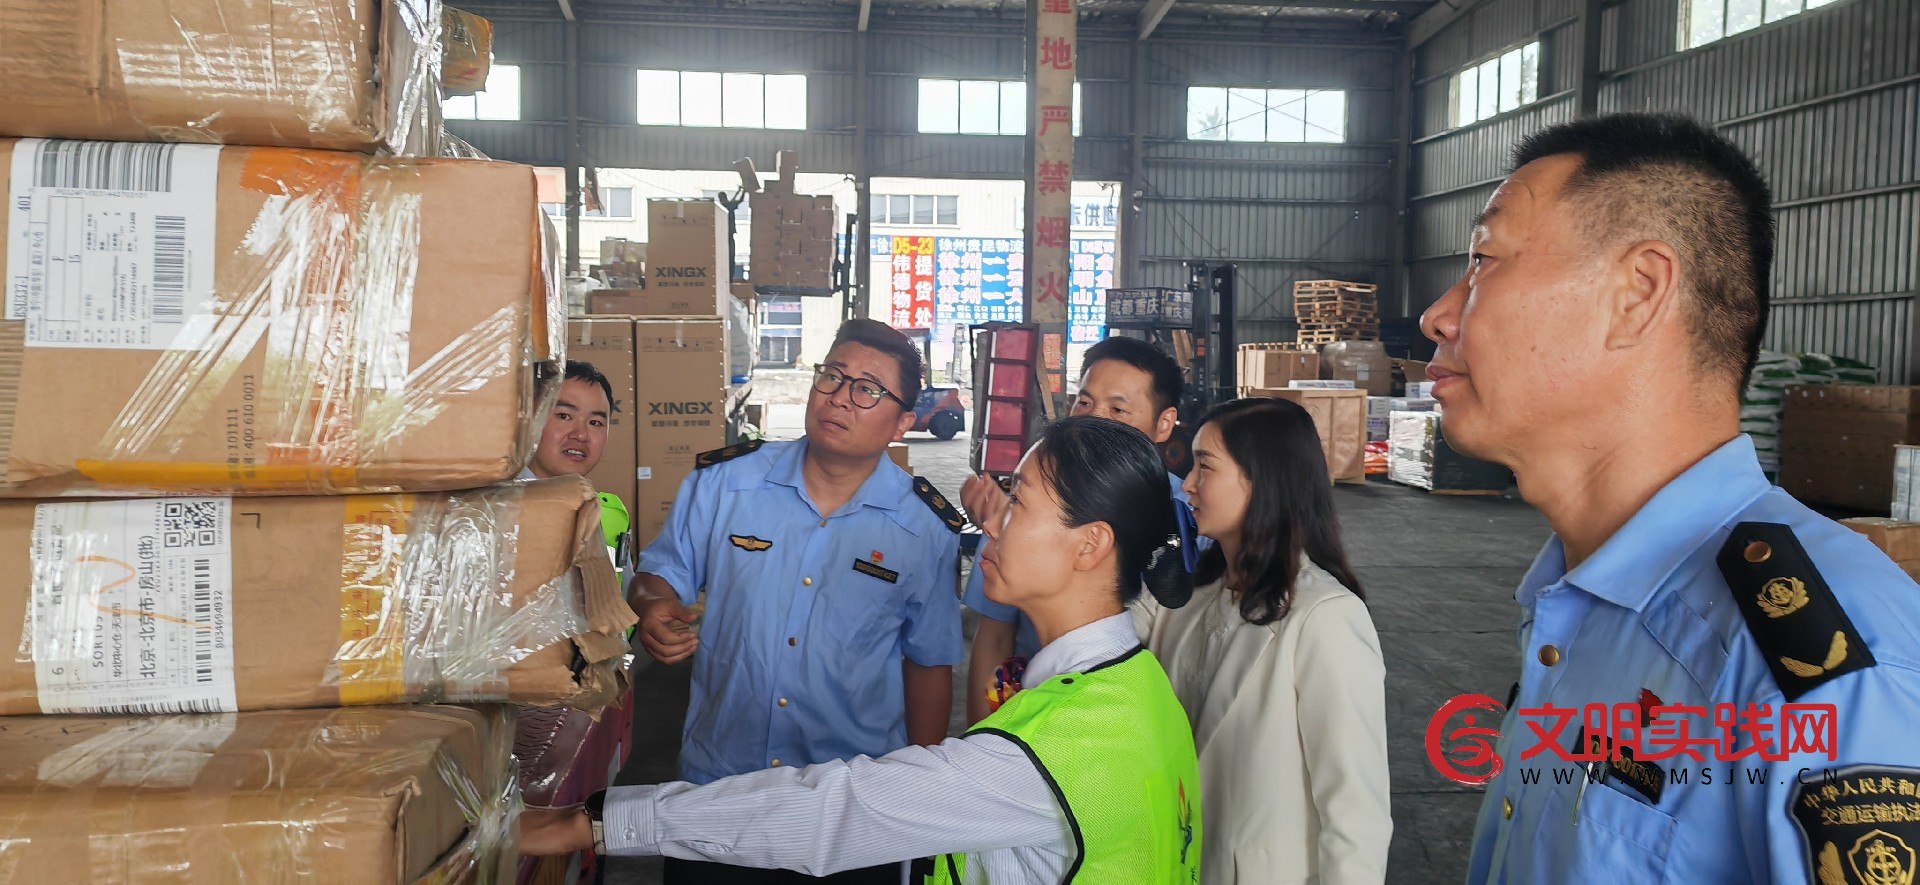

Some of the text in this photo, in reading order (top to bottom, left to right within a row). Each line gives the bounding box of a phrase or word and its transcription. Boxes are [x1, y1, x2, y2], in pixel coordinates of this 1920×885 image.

[17, 195, 31, 212] 401
[892, 237, 932, 255] D5-23
[937, 251, 982, 269] 徐州
[655, 266, 707, 278] XINGX
[937, 269, 981, 287] 徐州
[892, 255, 911, 328] 伟德物流
[914, 255, 933, 328] 提货处
[937, 286, 981, 304] 徐州
[1110, 297, 1159, 316] 成都重庆
[243, 374, 254, 401] 0011
[243, 404, 254, 425] 610
[649, 401, 713, 415] XINGX
[226, 408, 238, 450] 101111
[243, 428, 255, 449] 400
[138, 535, 157, 679] 北京-北京市-房山(批)
[51, 666, 65, 676] 6
[1803, 776, 1920, 809] 中华人民共和
